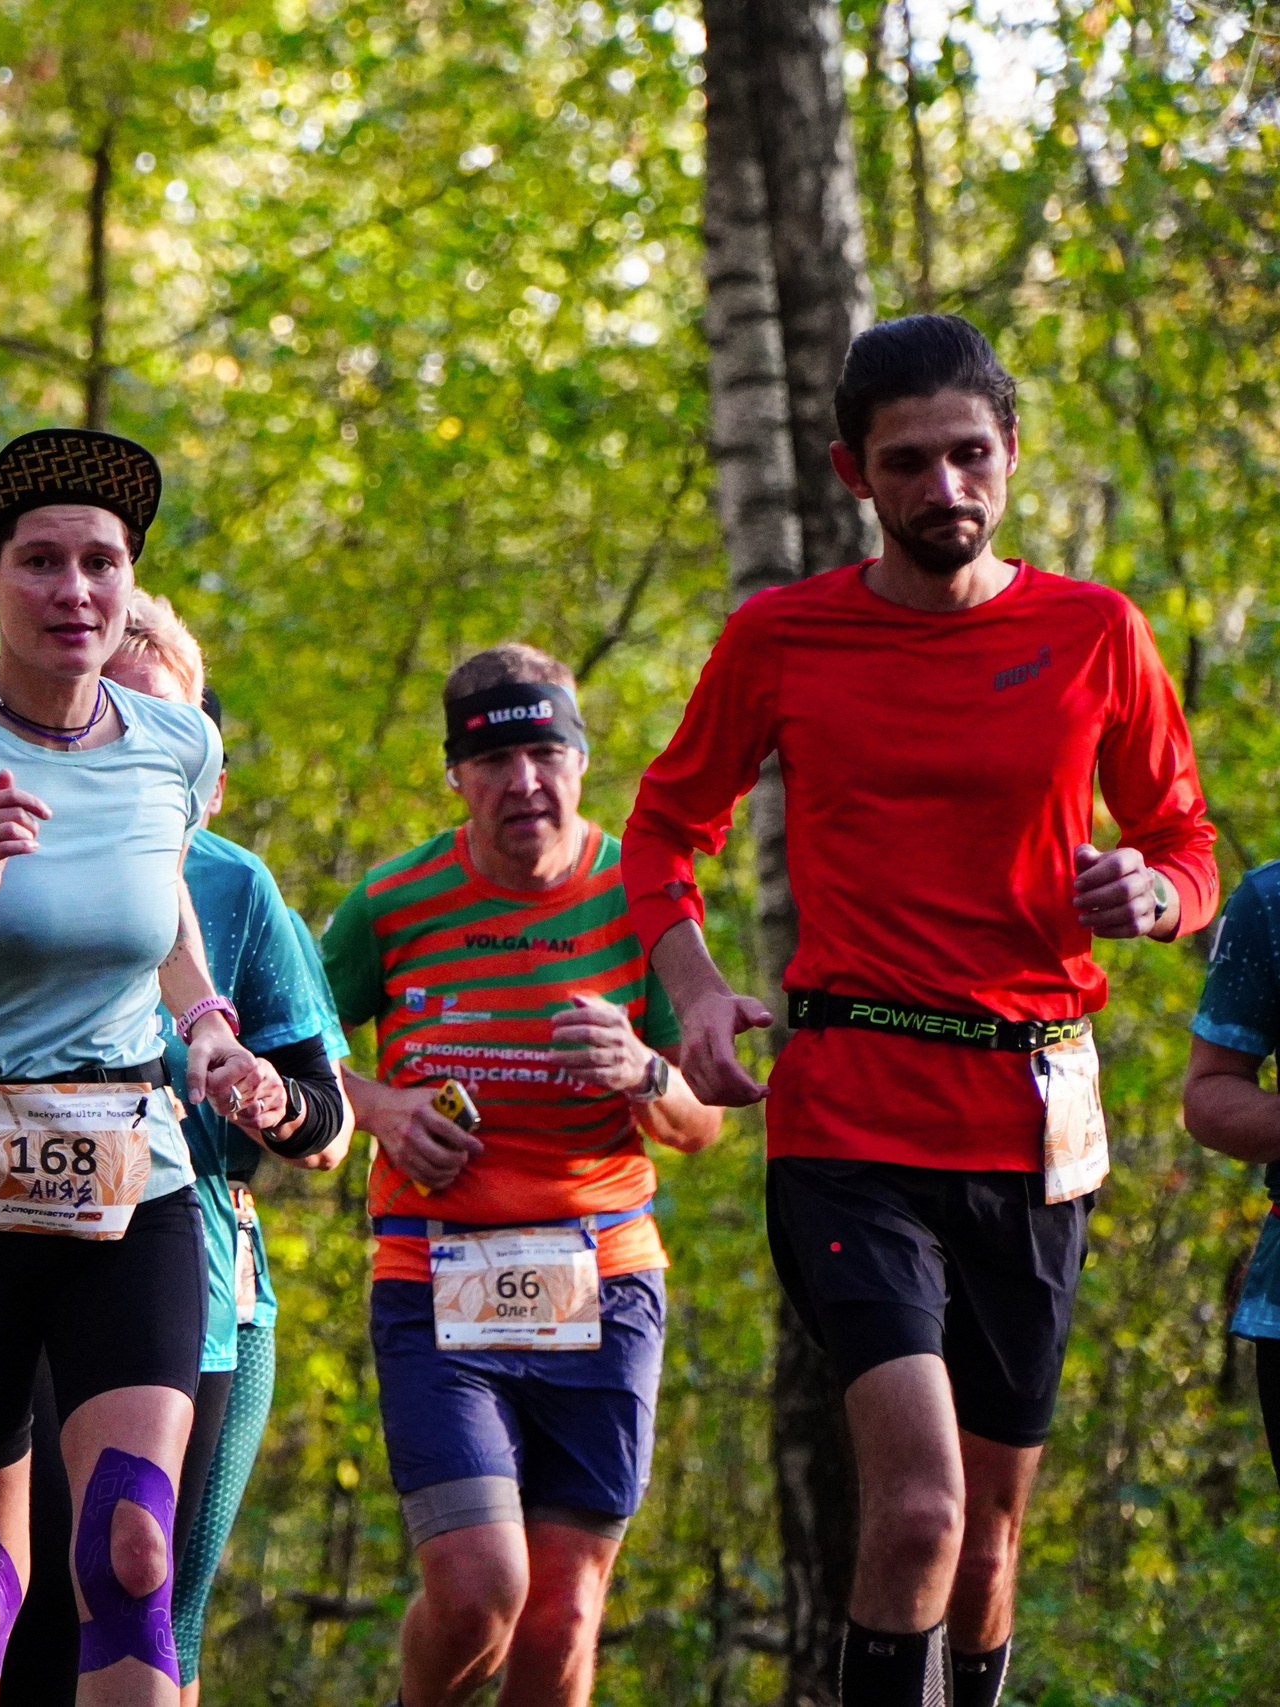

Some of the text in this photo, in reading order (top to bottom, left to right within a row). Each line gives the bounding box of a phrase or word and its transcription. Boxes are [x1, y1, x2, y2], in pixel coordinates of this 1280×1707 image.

[464, 934, 575, 954] VOLGAMAN
[426, 1044, 552, 1062] ЭКОЛОГИЧЕСКИ
[28, 1110, 135, 1119] Backyard Ultra Moscow
[10, 1137, 97, 1175] 168
[78, 1212, 103, 1221] PRO
[497, 1270, 540, 1299] 66
[496, 1303, 538, 1317] Олег
